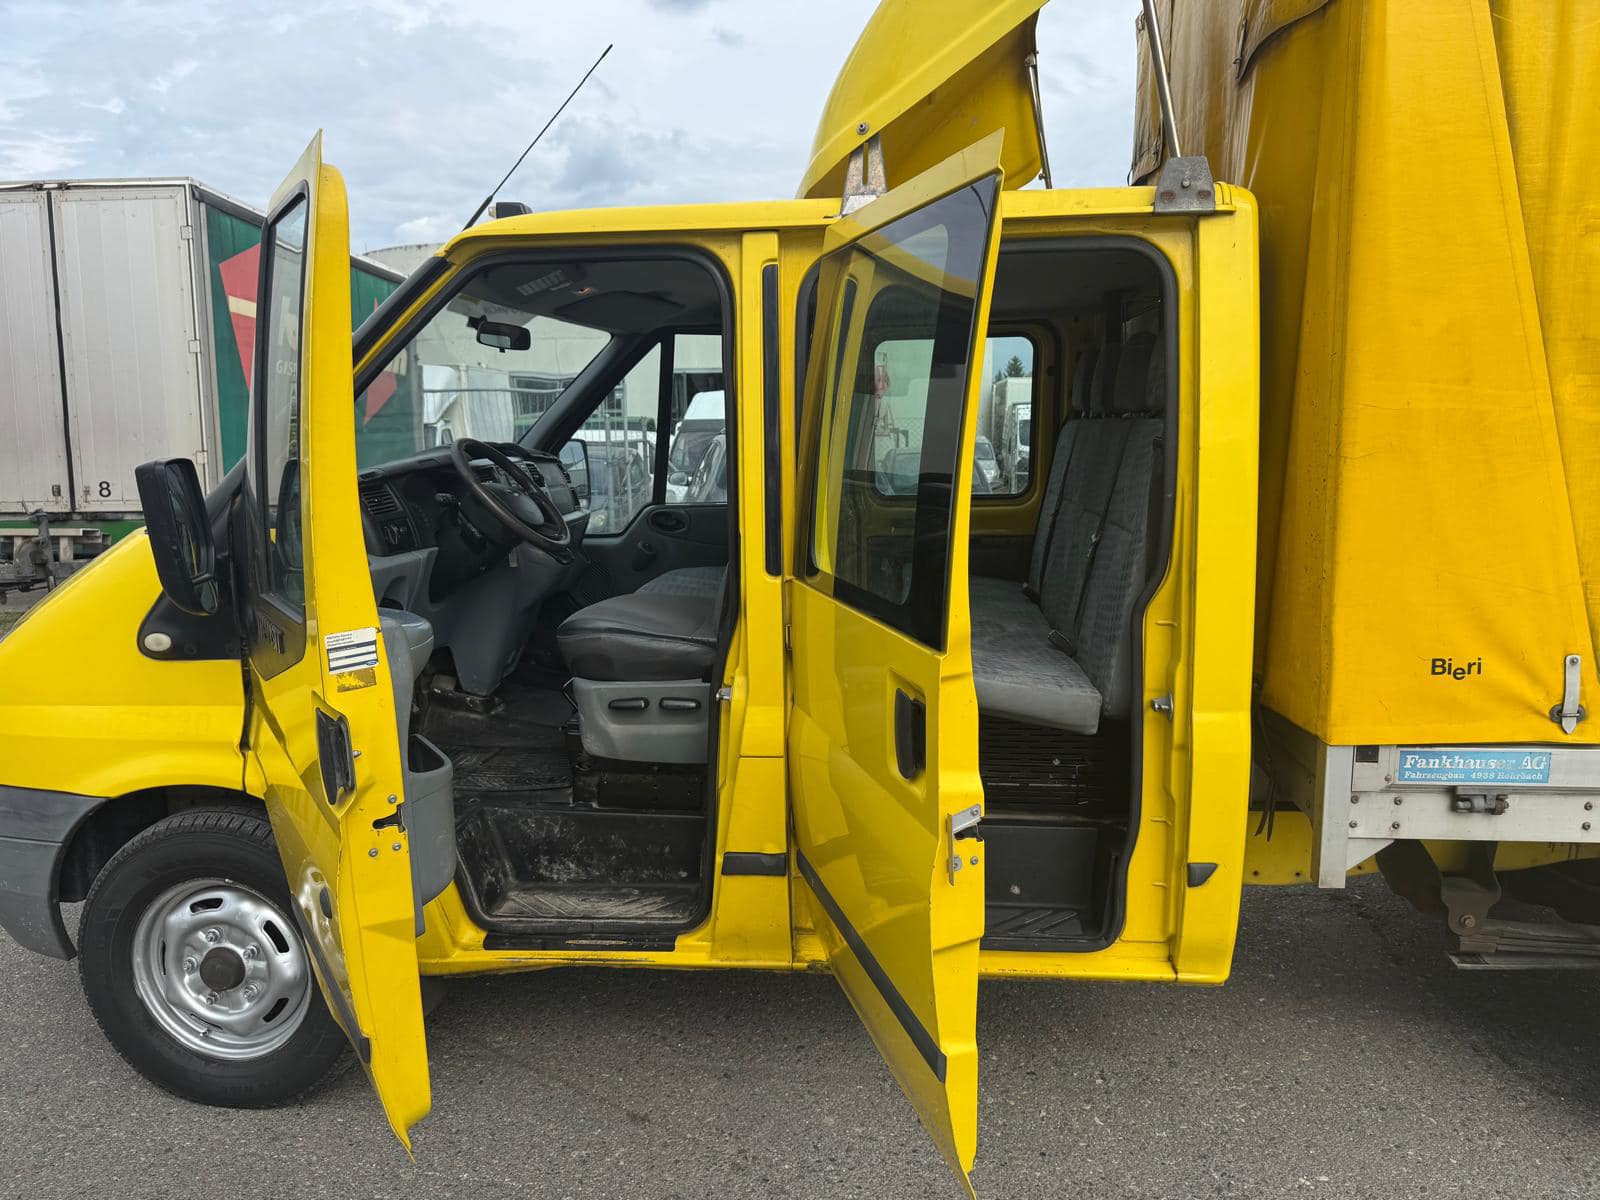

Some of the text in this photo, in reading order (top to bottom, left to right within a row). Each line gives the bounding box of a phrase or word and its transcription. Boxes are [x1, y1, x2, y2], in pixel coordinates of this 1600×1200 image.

[99, 481, 111, 498] 8
[1431, 657, 1481, 680] Bieri
[1403, 755, 1547, 770] Fankhauser AG
